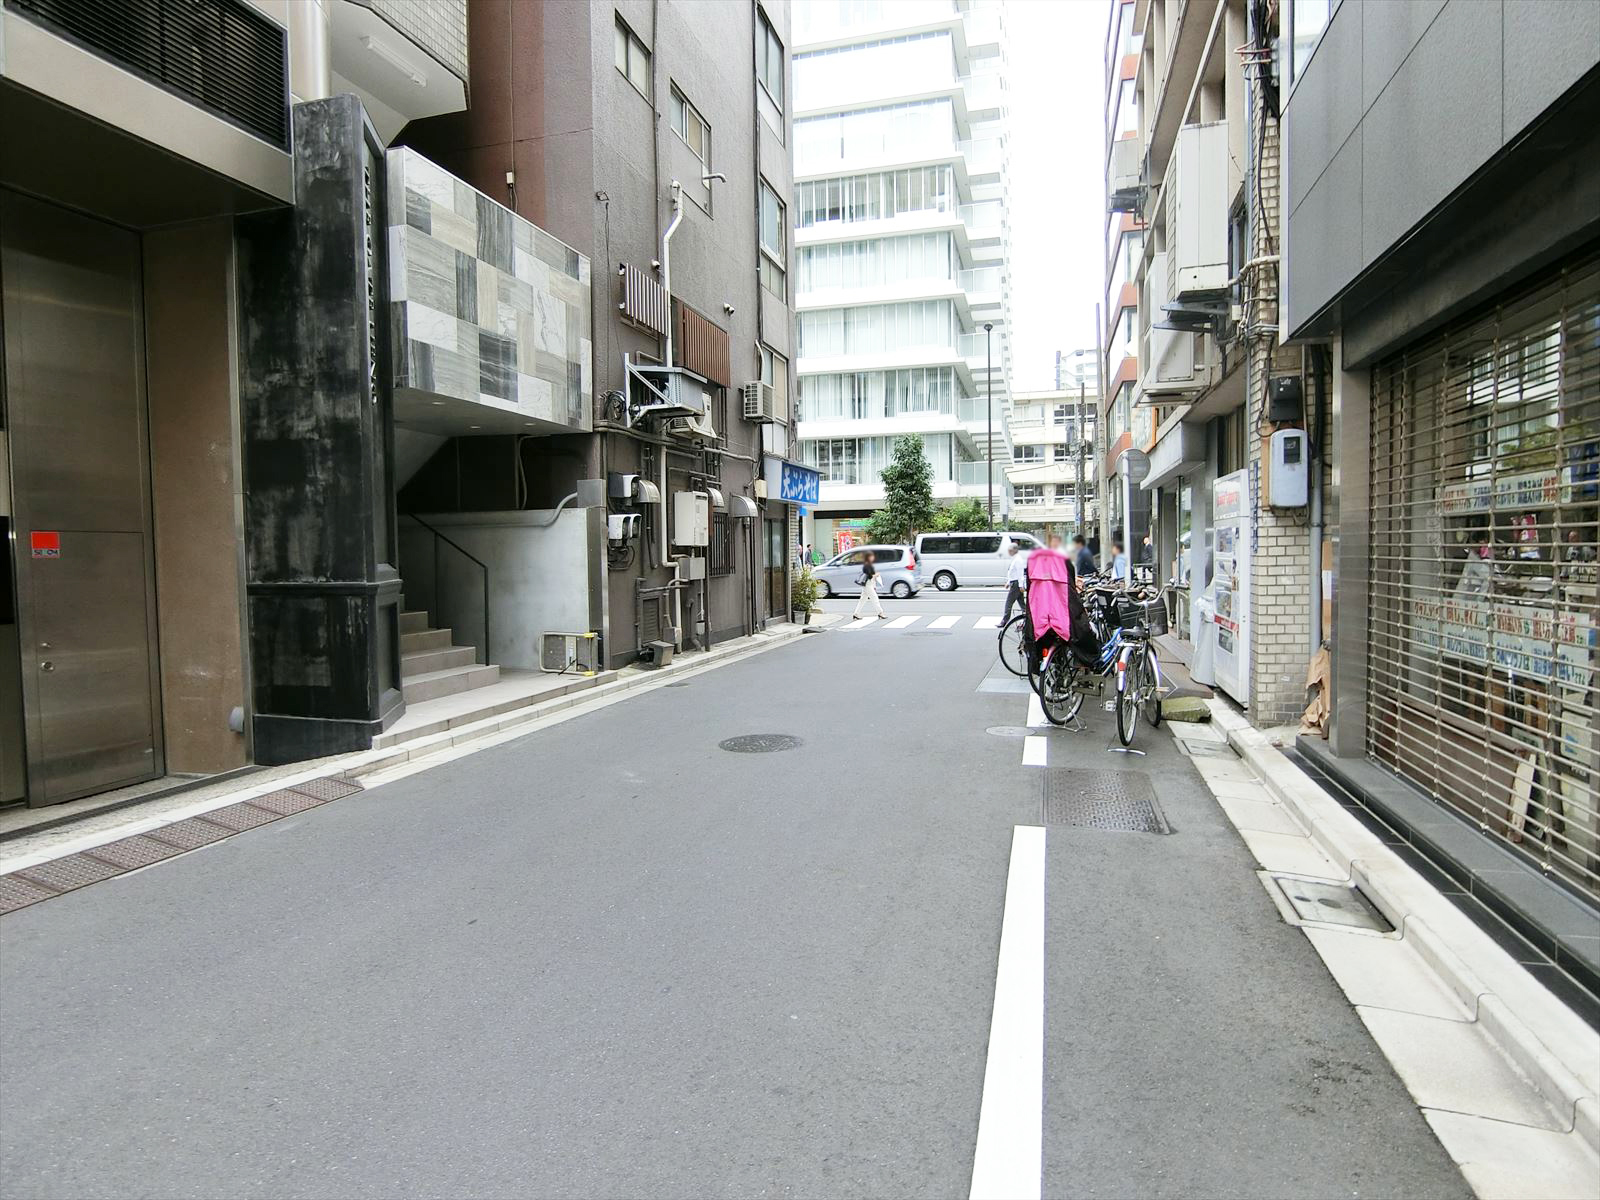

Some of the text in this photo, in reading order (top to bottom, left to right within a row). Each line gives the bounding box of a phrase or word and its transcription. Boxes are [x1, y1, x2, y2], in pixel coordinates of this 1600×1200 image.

[782, 466, 818, 501] 天ぷらそば
